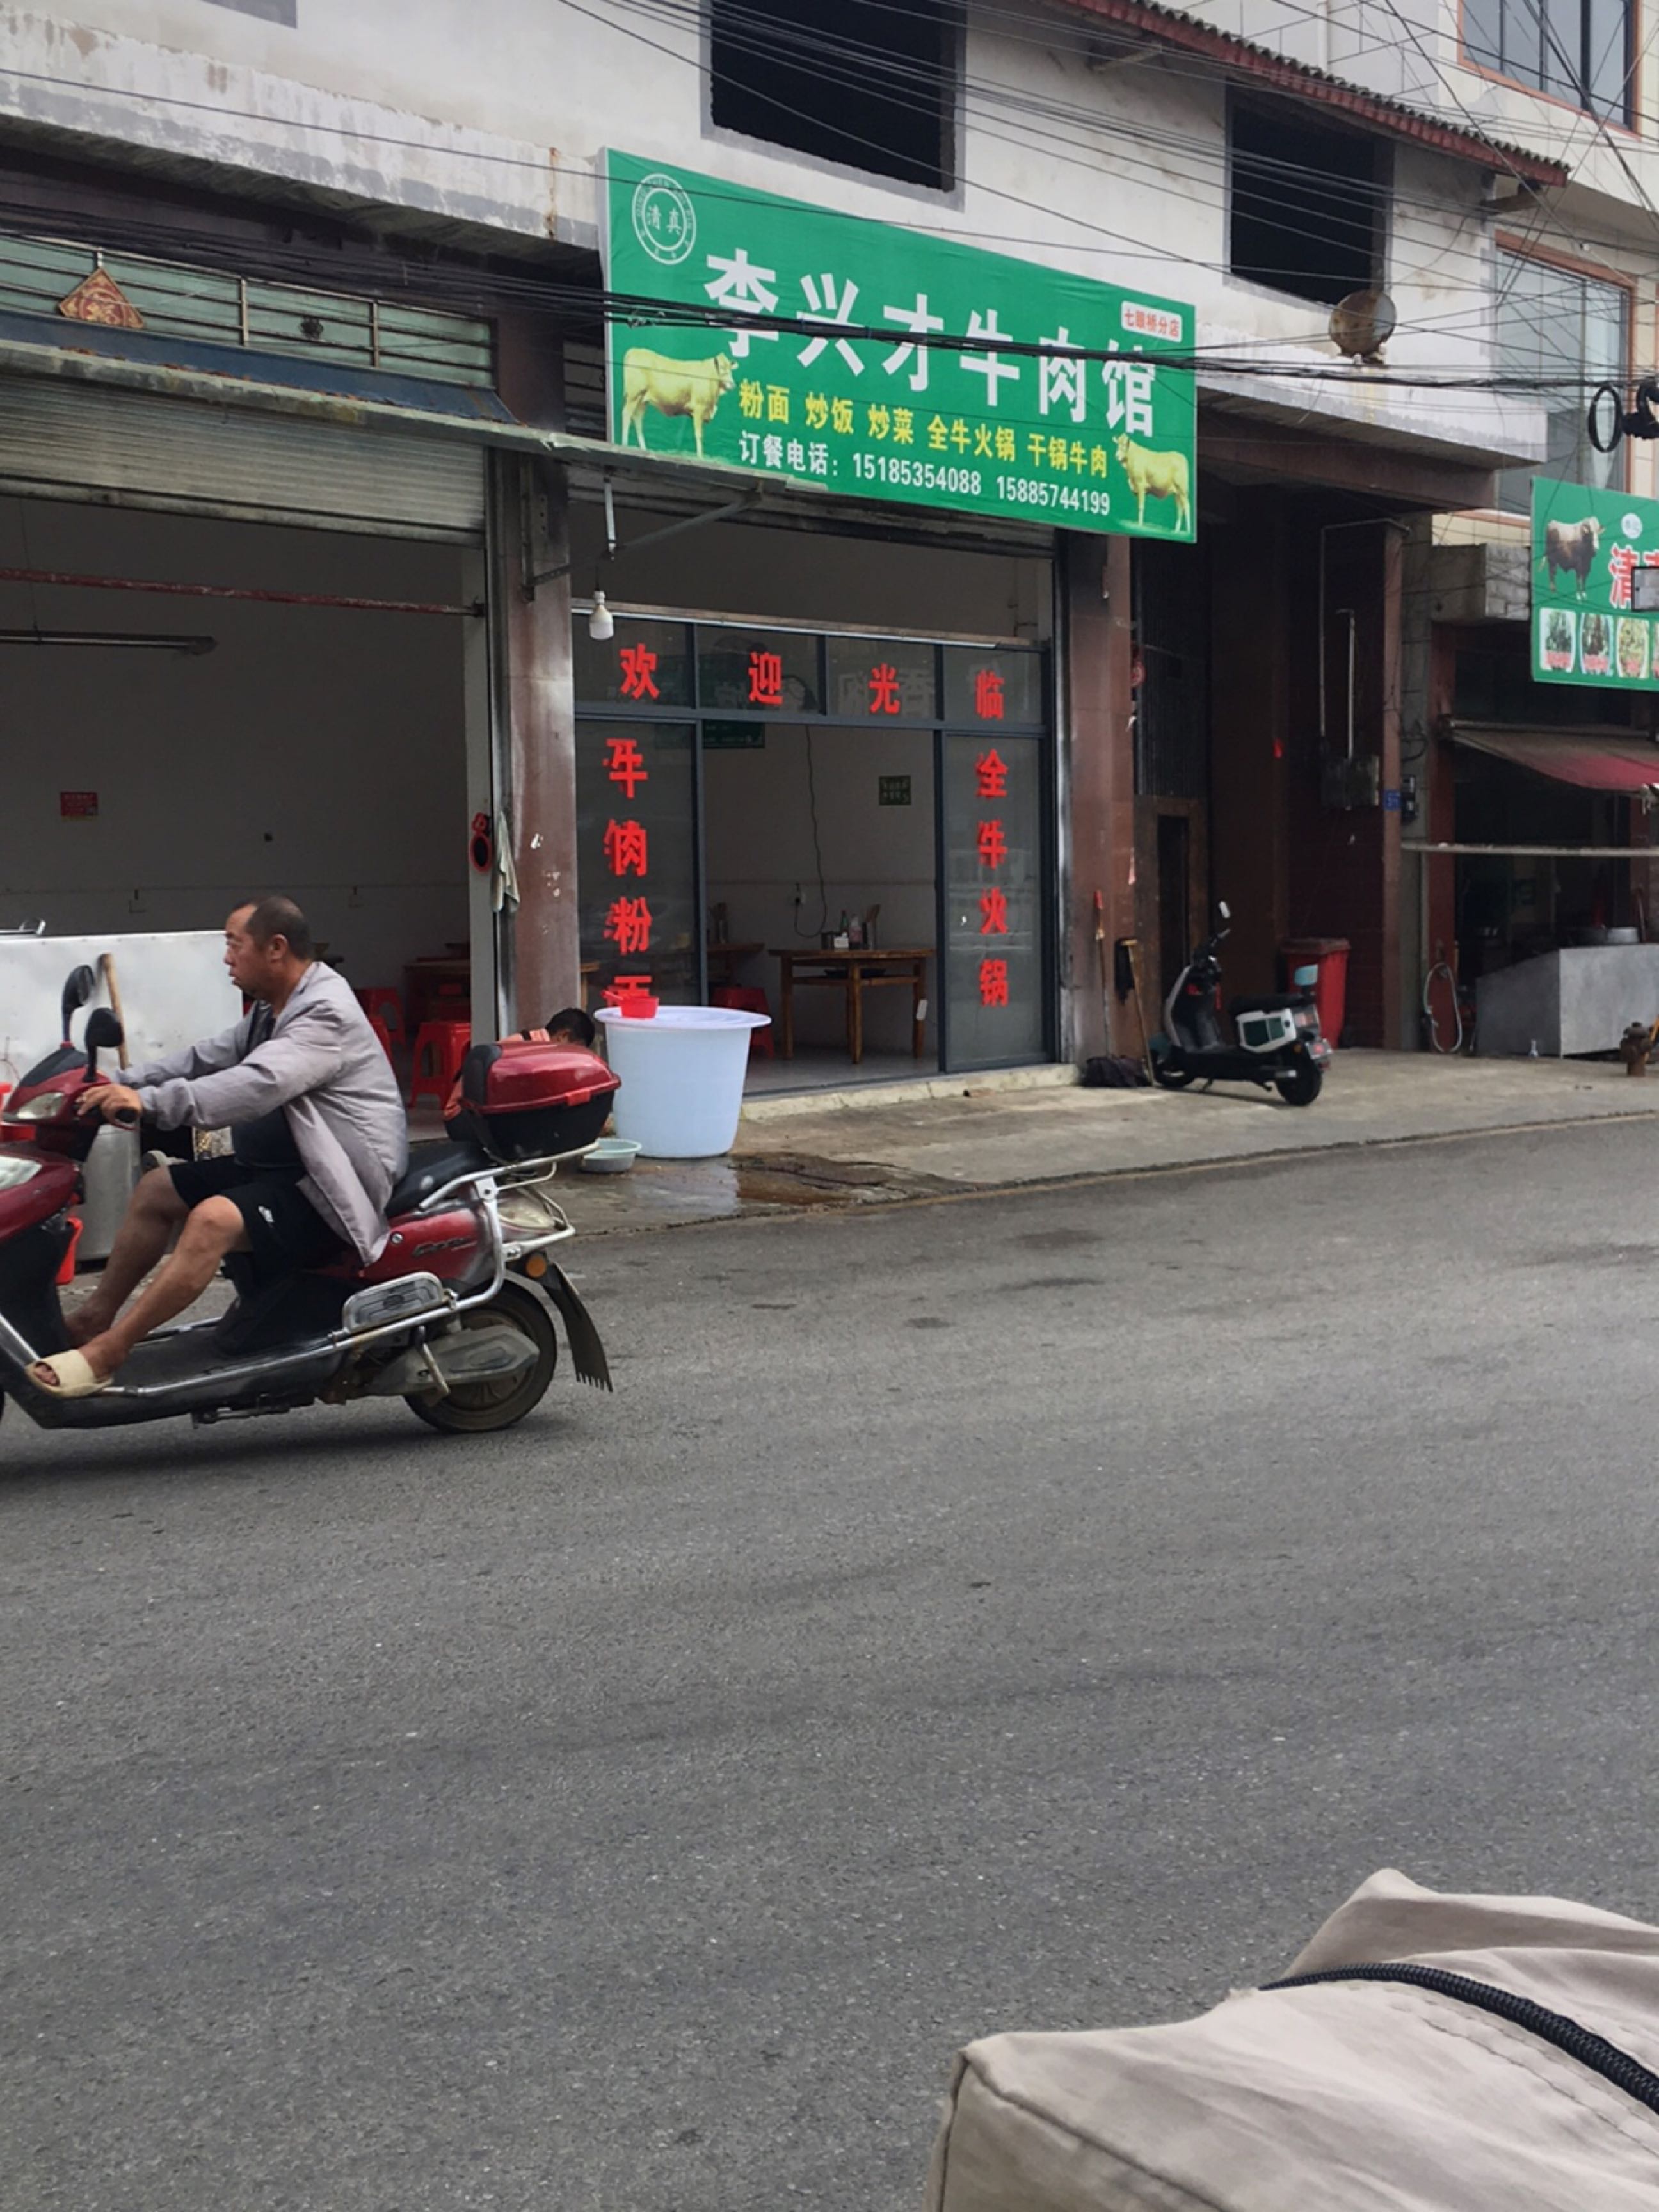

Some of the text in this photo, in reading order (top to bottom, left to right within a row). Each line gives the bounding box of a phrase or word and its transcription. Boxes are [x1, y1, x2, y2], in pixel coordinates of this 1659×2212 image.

[704, 247, 1157, 438] 李兴才牛肉馆
[739, 378, 1107, 479] 粉面 炒饭 炒菜 全牛火锅 干锅牛肉
[853, 453, 981, 495] 15185354088
[997, 476, 1110, 516] 15885744199
[620, 643, 1006, 720] 欢迎光临
[976, 749, 1009, 1007] 全牛火锅
